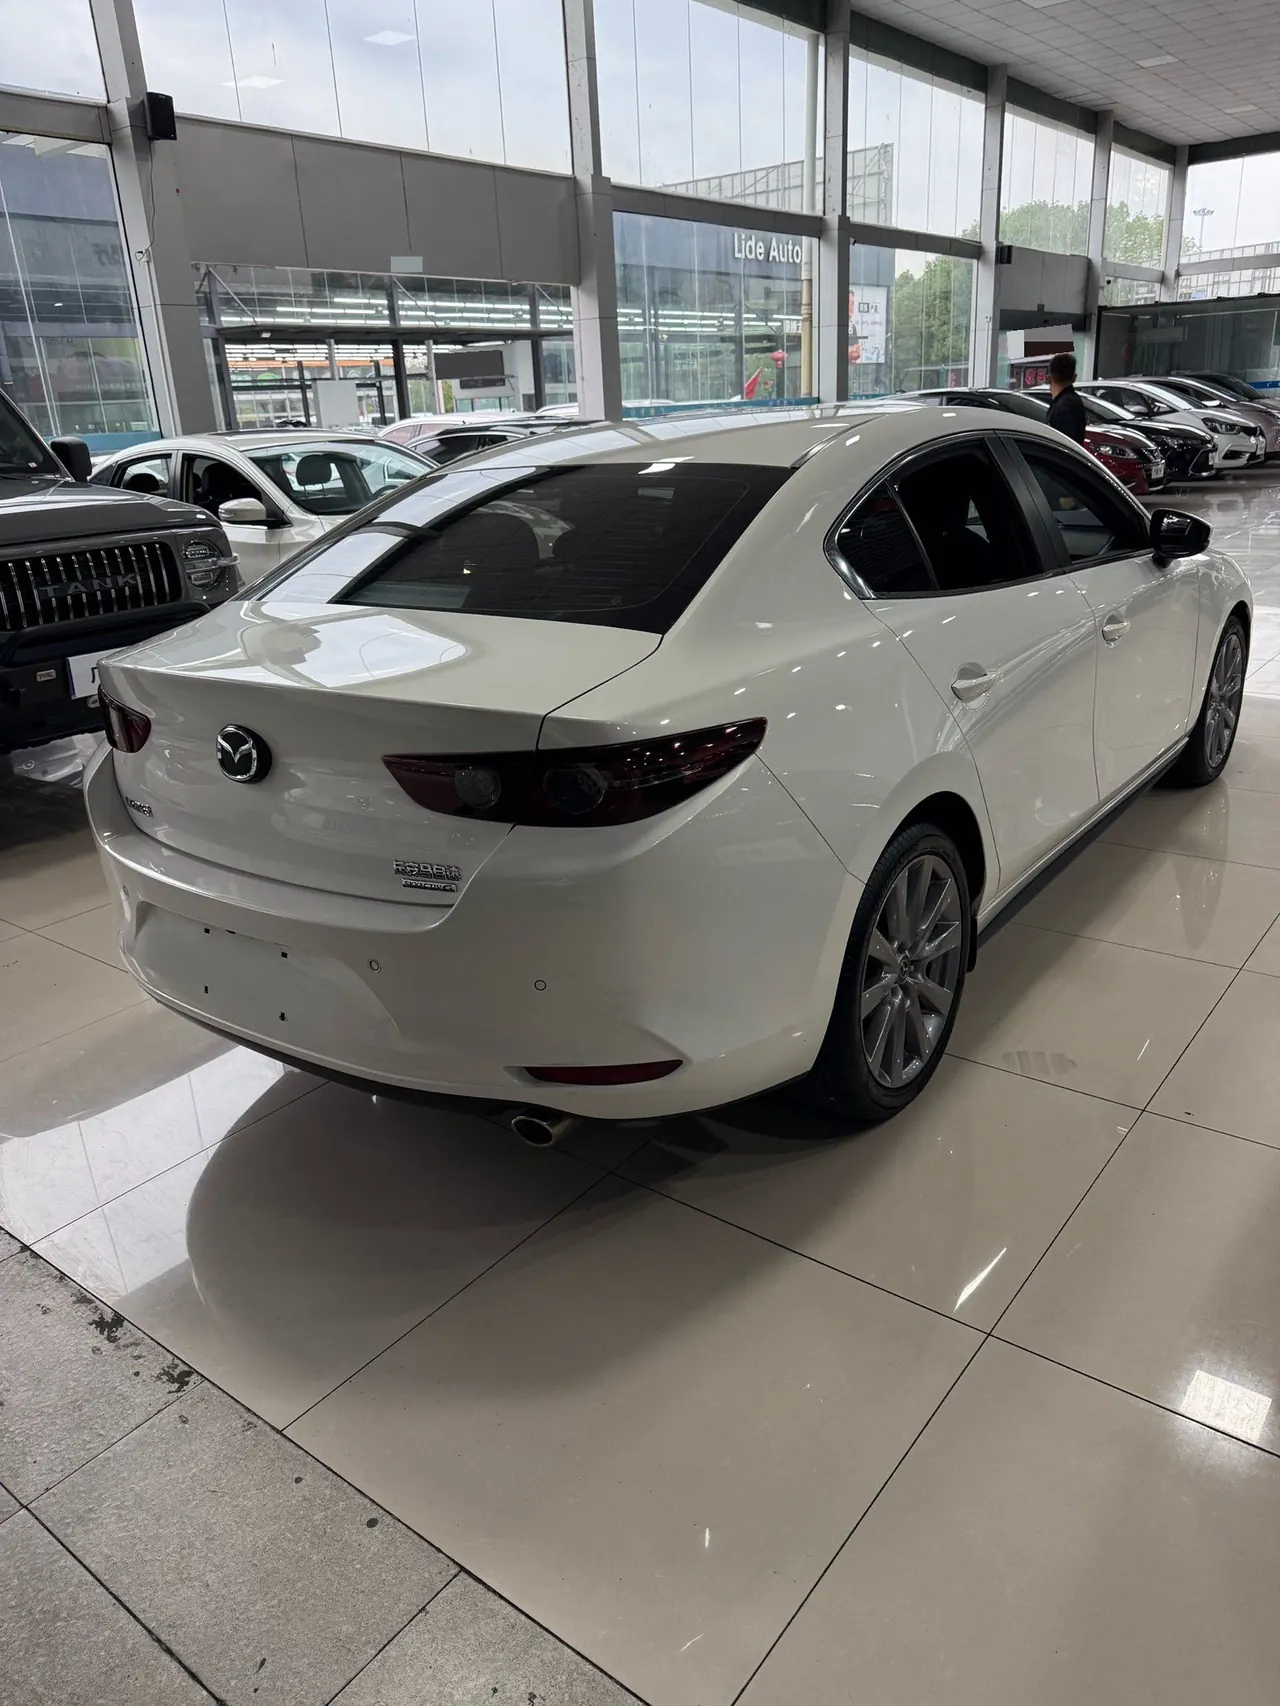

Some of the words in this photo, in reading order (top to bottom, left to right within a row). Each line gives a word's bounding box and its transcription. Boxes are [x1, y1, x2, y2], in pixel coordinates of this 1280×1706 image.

[734, 232, 765, 261] Lide
[769, 236, 802, 264] Auto
[39, 573, 137, 597] TANK
